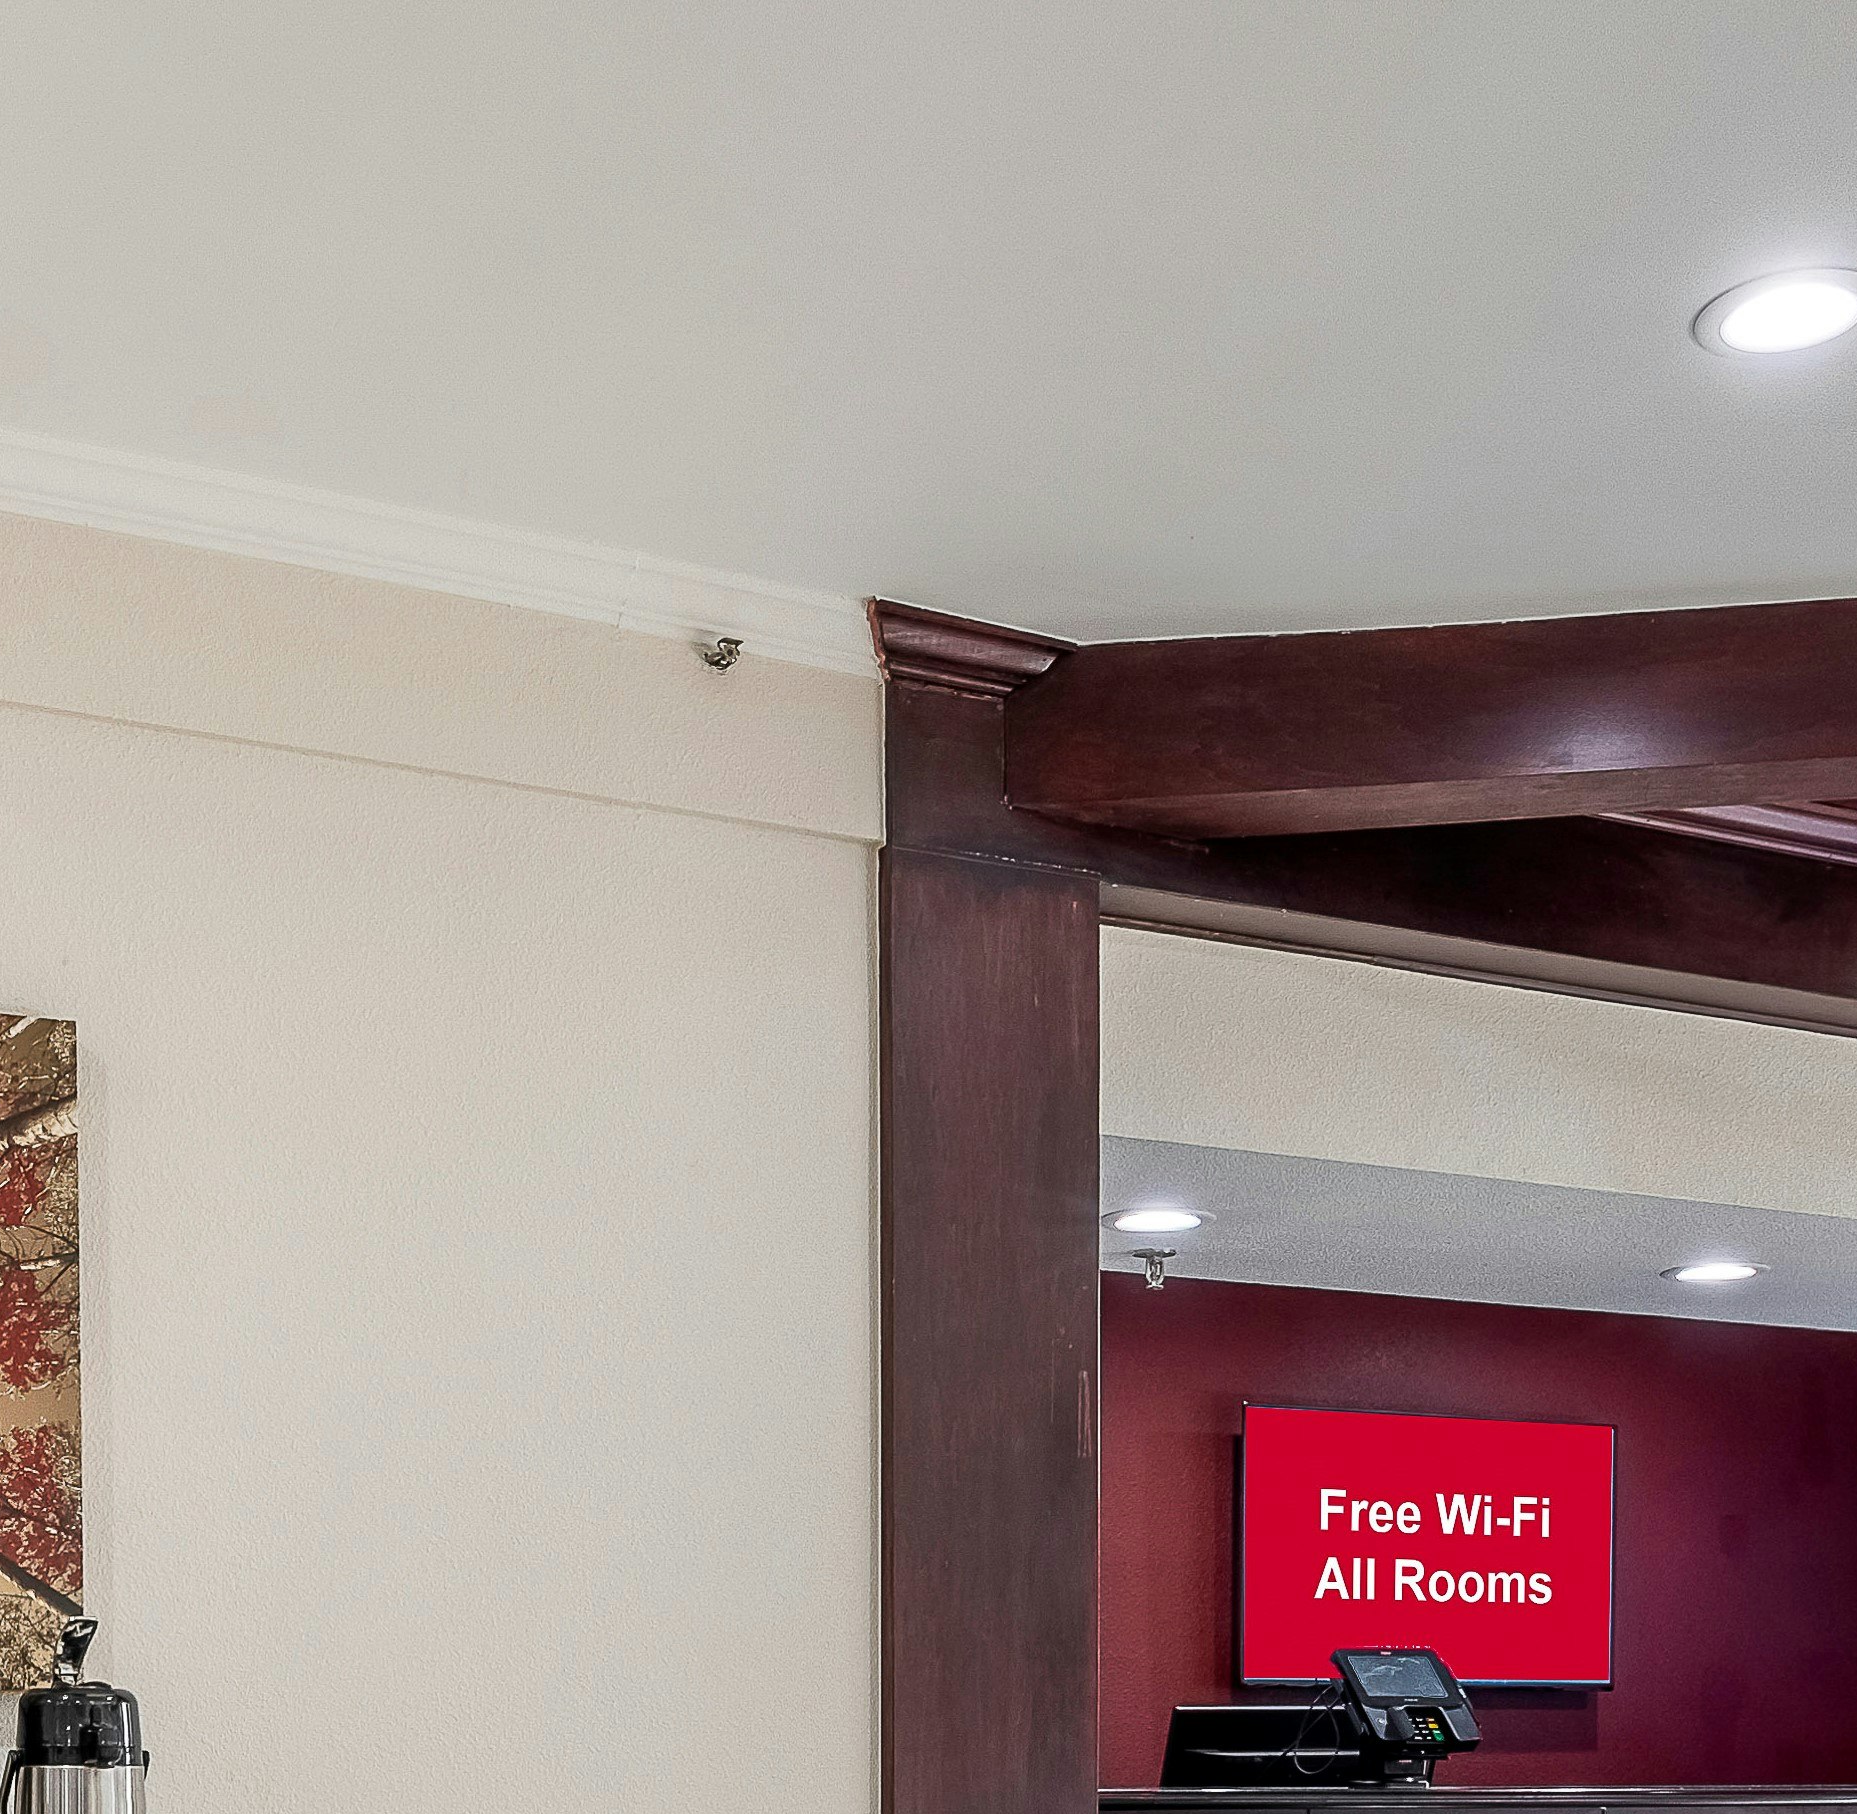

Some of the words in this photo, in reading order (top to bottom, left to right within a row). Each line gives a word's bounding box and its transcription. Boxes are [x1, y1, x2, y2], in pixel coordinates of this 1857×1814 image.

[1319, 1488, 1422, 1534] Free
[1435, 1493, 1551, 1538] Wi-Fi
[1313, 1556, 1377, 1600] All
[1393, 1559, 1553, 1605] Rooms
